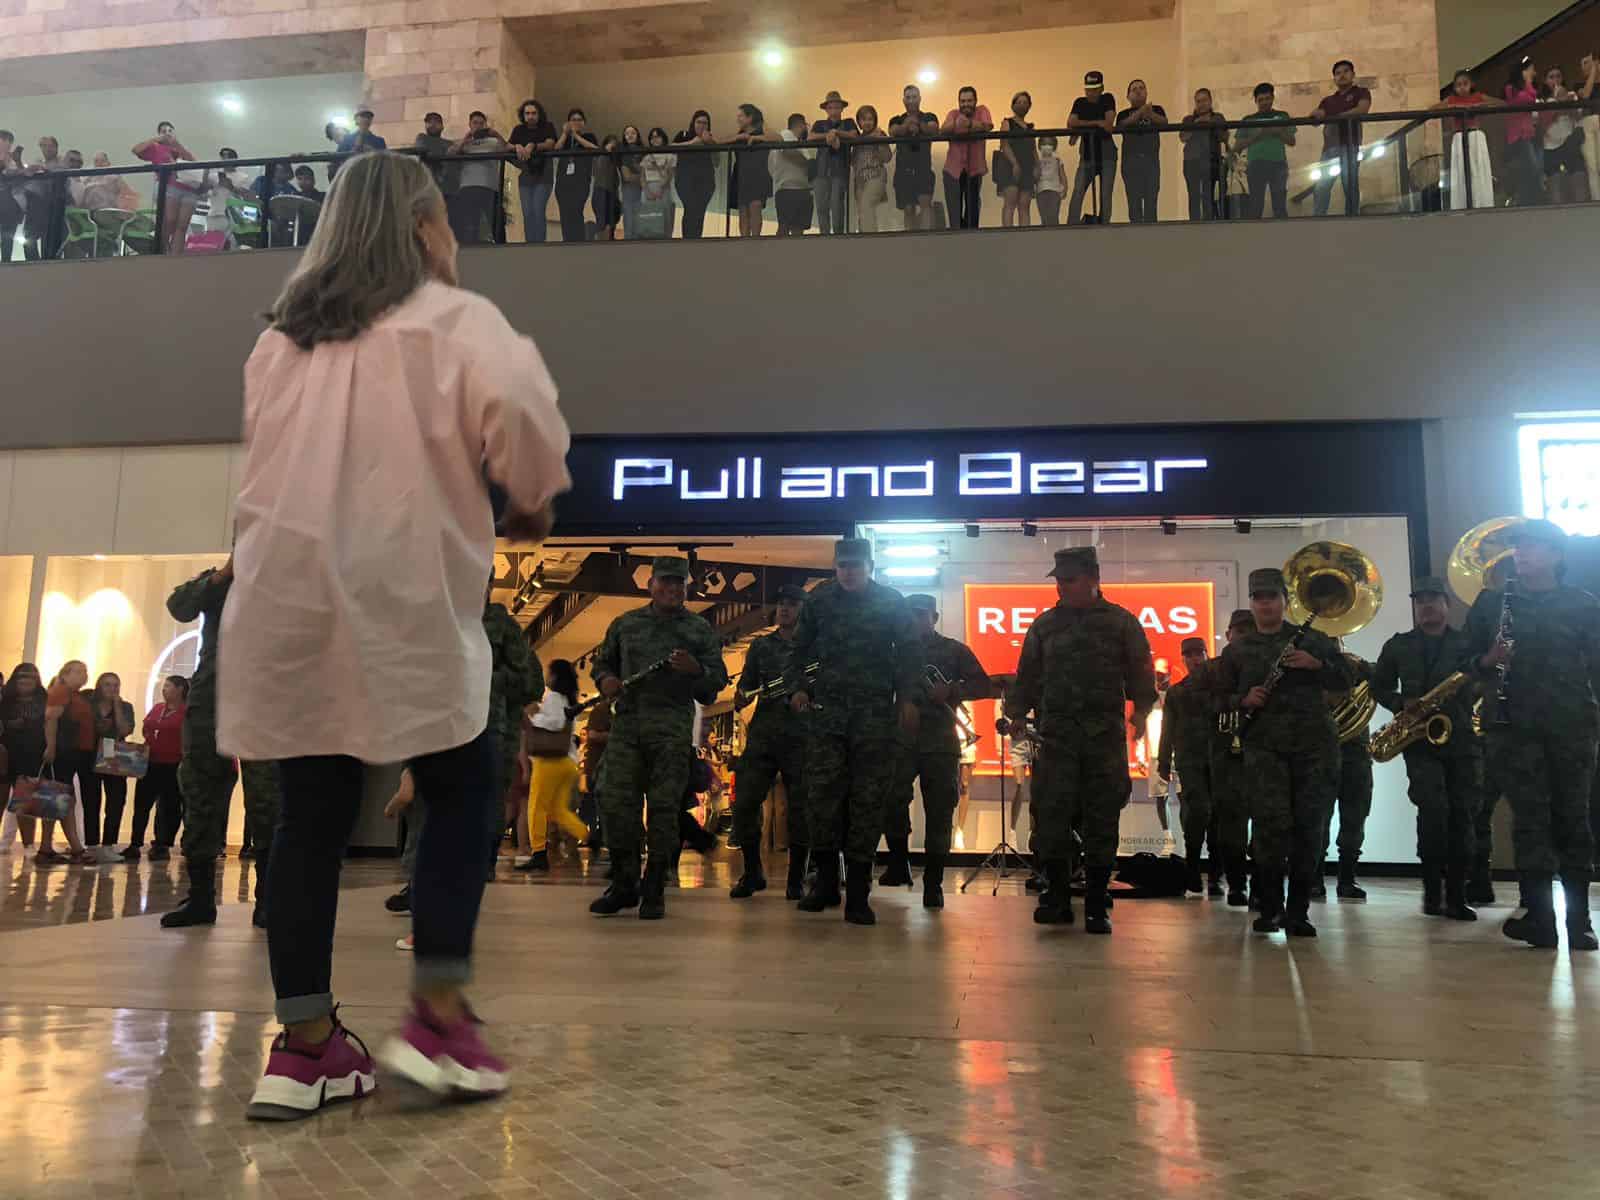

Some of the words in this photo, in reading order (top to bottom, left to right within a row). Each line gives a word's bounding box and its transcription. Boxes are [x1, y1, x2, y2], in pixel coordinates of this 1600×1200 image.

[613, 457, 761, 500] Pull
[781, 460, 934, 498] and
[959, 452, 1207, 495] Bear
[977, 606, 1199, 635] REAS
